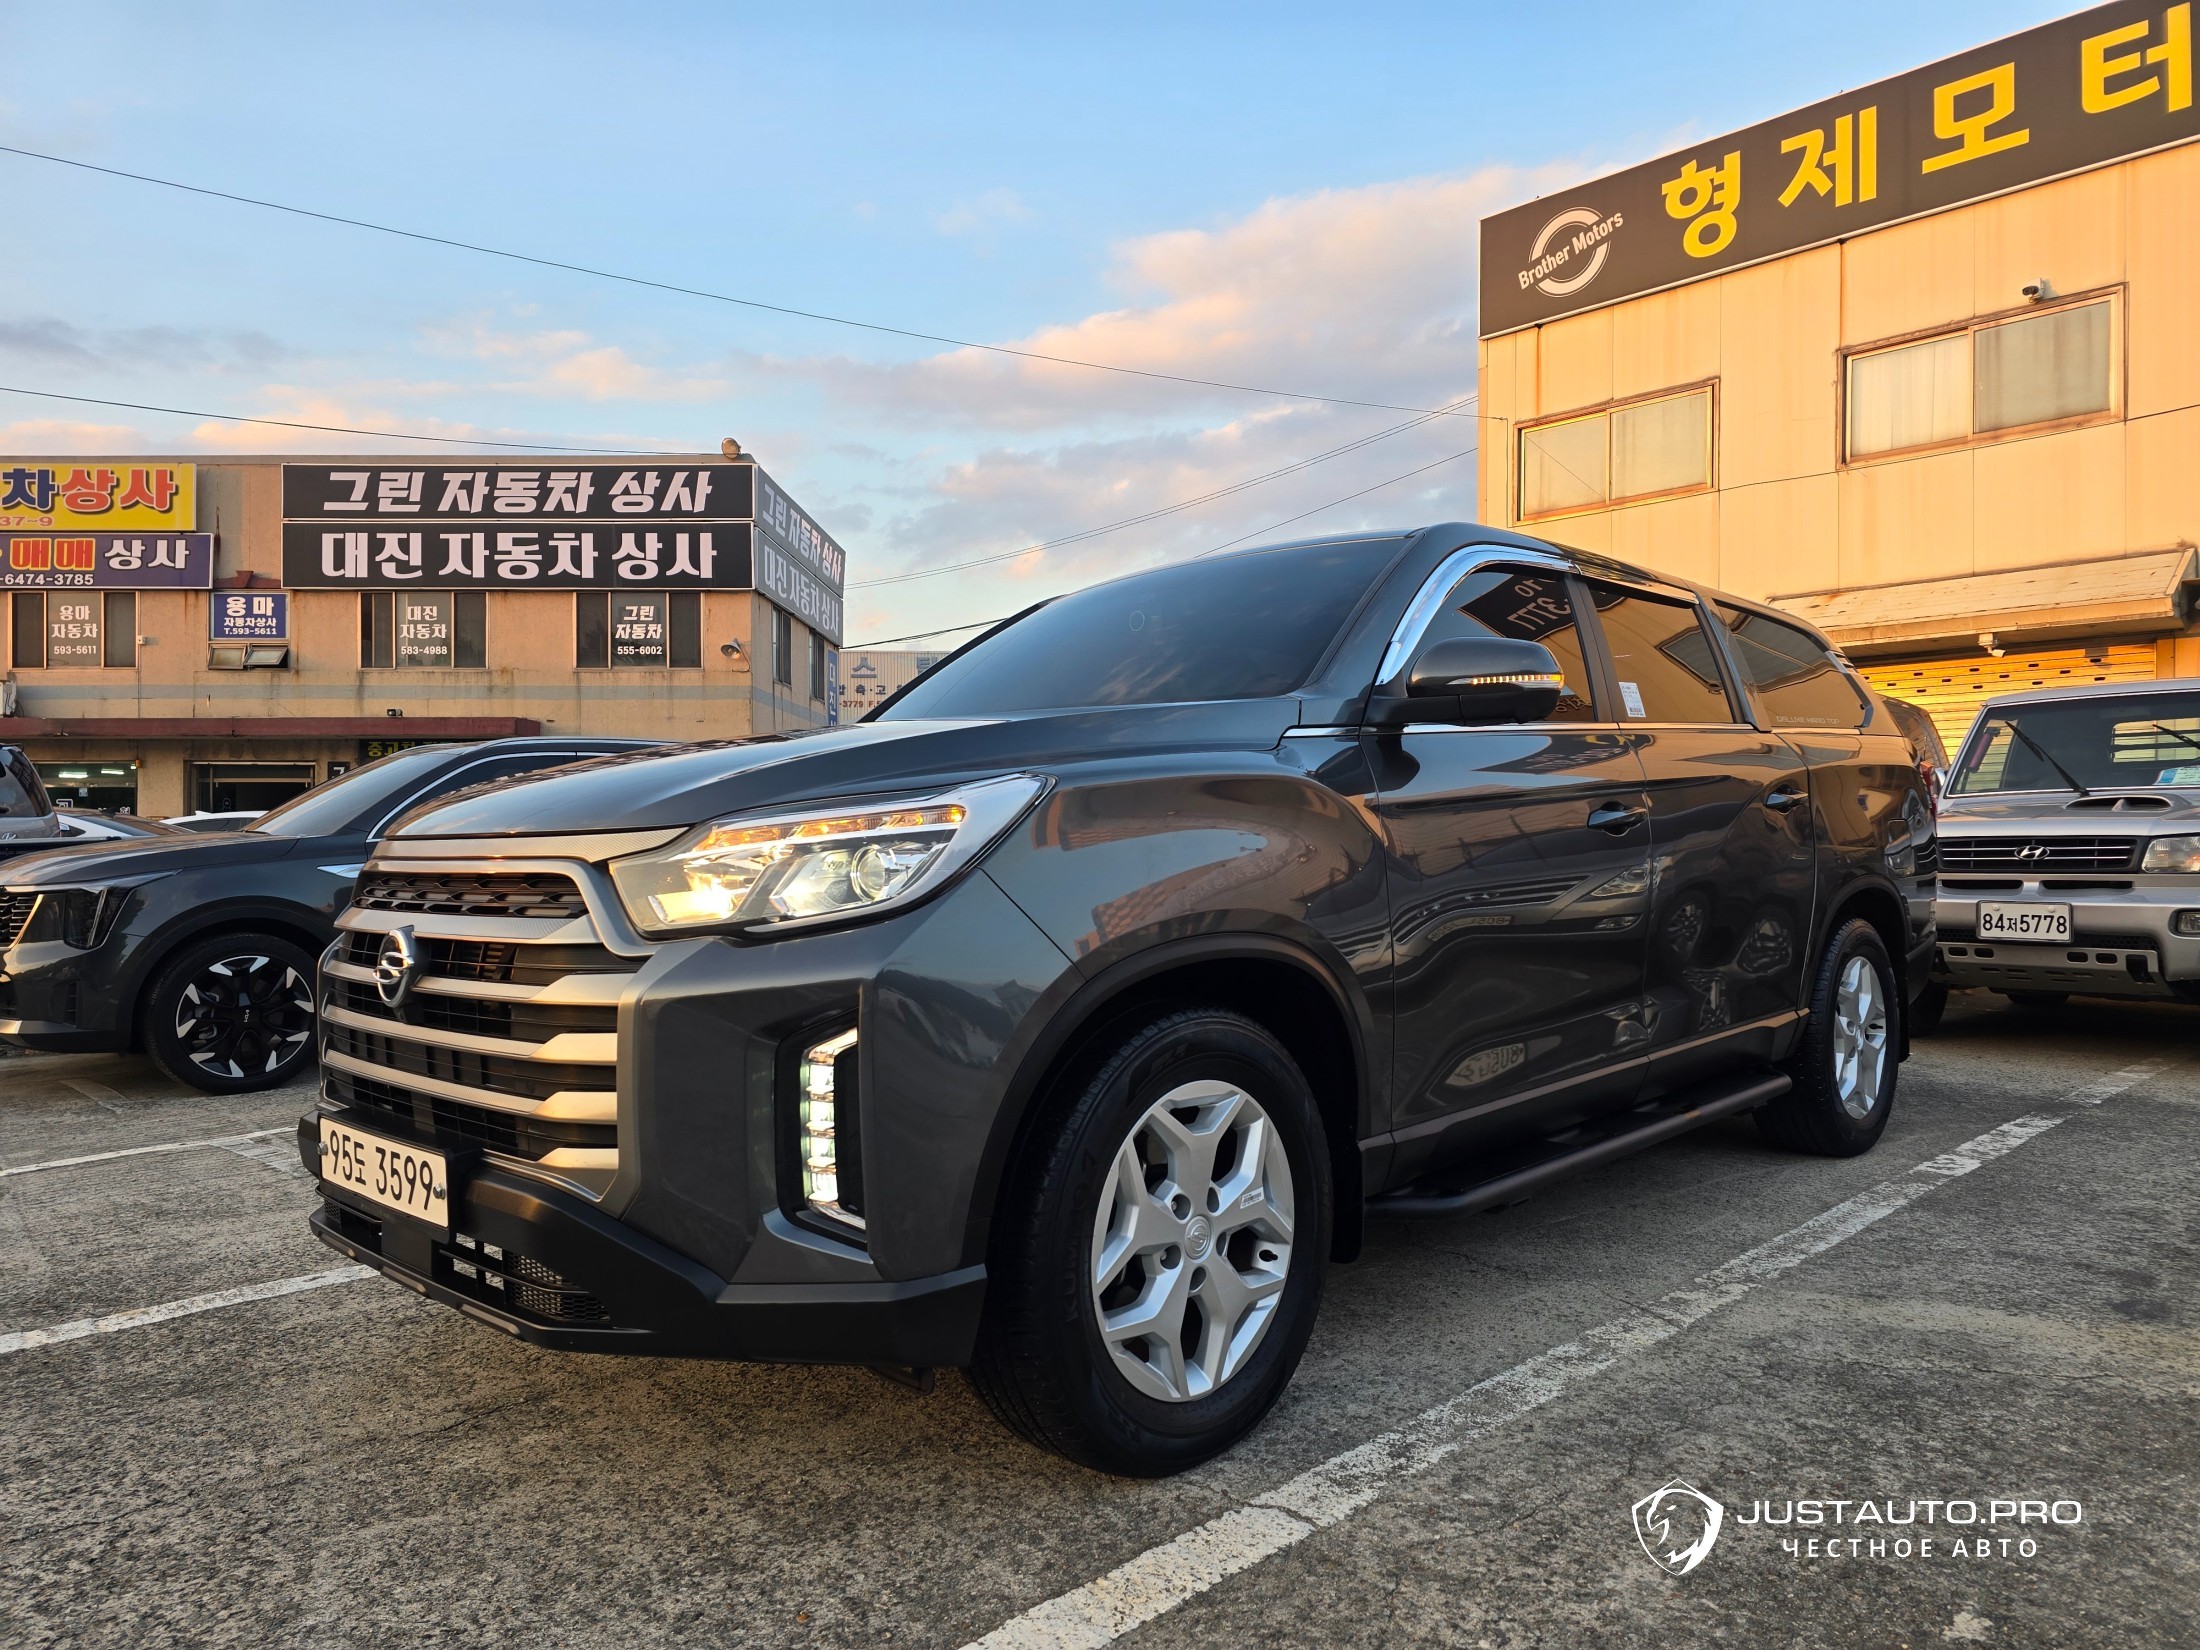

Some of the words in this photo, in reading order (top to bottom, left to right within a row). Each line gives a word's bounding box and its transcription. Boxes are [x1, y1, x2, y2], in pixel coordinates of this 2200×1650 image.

[1518, 244, 1570, 290] Brother
[1572, 212, 1624, 254] Motors
[323, 471, 425, 512] 그린
[437, 471, 595, 513] 자동차
[608, 471, 713, 513] 상사
[762, 483, 787, 537] 그린
[788, 508, 821, 567] 자동차
[822, 541, 842, 586] 상사
[10, 538, 95, 571] 매매
[105, 539, 190, 569] 상사
[322, 532, 423, 580] 대진
[438, 532, 598, 580] 자동차
[612, 532, 717, 580] 상사
[764, 545, 787, 598] 대진
[790, 565, 820, 622] 자동차
[822, 592, 839, 636] 상사
[60, 605, 90, 620] 용마
[407, 605, 438, 620] 대진
[623, 605, 655, 621] 그린
[51, 623, 98, 639] 자동차
[400, 624, 447, 639] 자동차
[615, 623, 663, 640] 자동차
[54, 645, 97, 655] 593-5611
[401, 646, 448, 655] 583-4988
[617, 645, 663, 655] 555-6002
[330, 1129, 367, 1186] 95도
[375, 1146, 433, 1211] 3599
